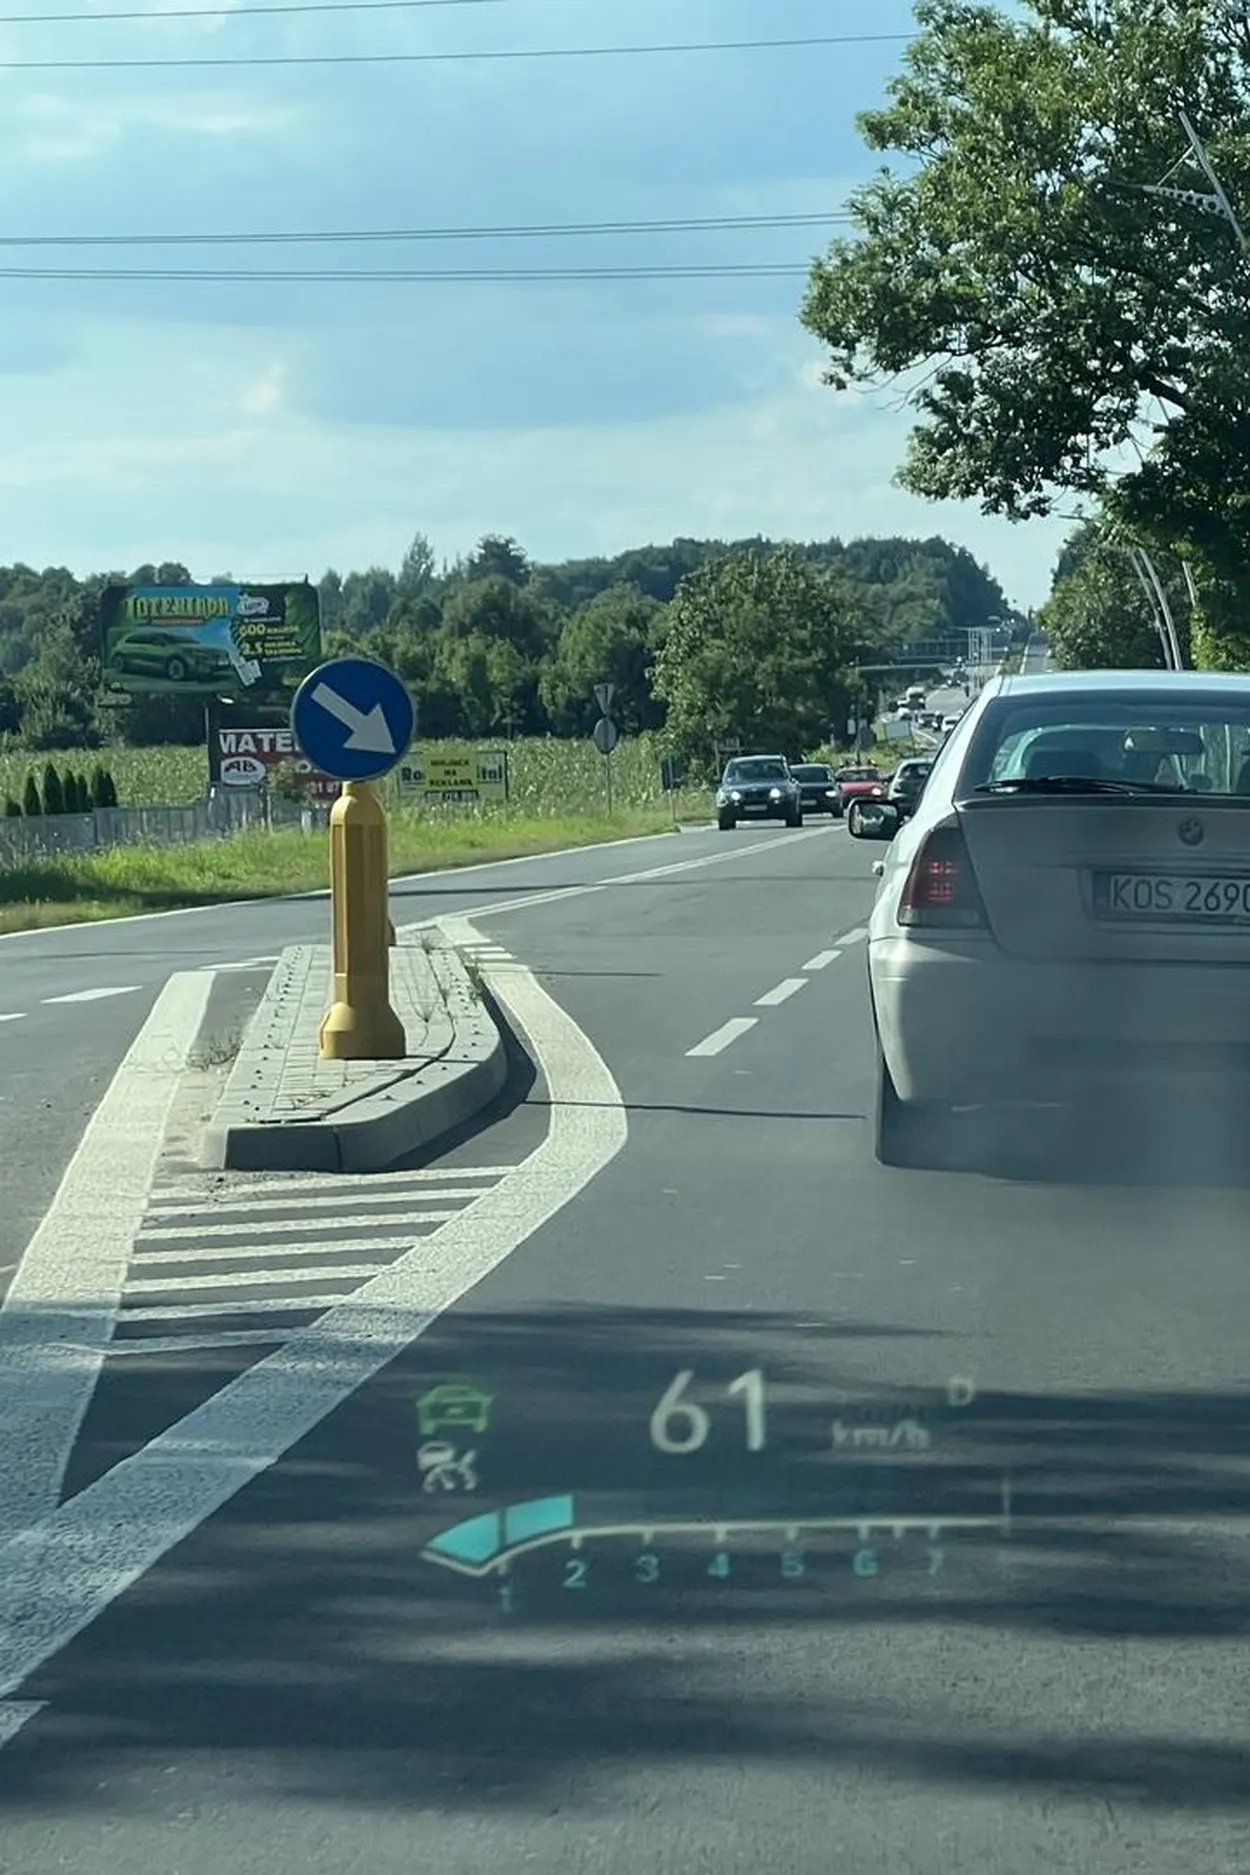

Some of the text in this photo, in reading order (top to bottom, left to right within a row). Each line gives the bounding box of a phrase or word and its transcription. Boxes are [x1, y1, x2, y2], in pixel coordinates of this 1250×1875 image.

[219, 733, 301, 753] MATE
[1112, 877, 1174, 910] KOS
[649, 1368, 768, 1454] 61
[832, 1418, 931, 1449] km/h
[563, 1560, 587, 1588] 2
[636, 1557, 659, 1583] 3
[707, 1554, 730, 1579] 4
[780, 1554, 806, 1577] 5
[853, 1551, 879, 1577] 6
